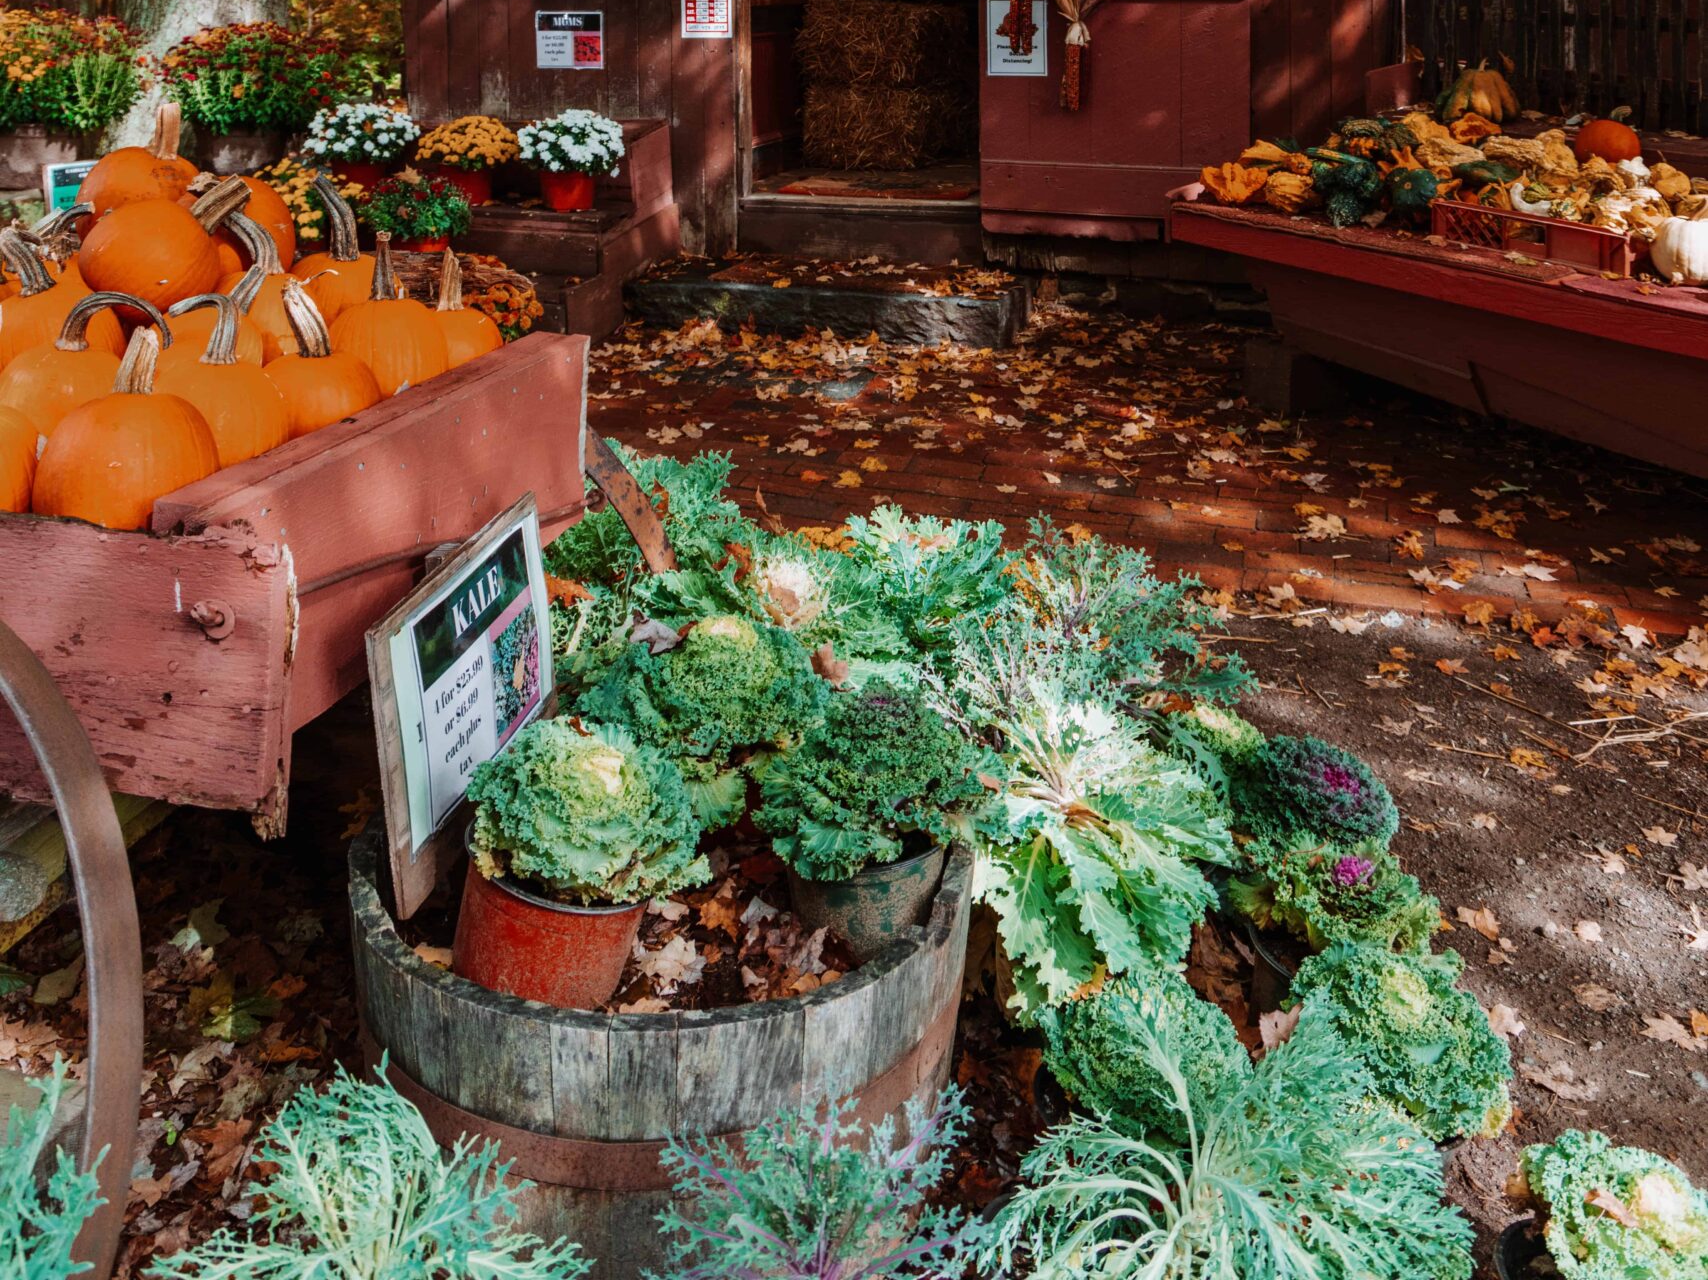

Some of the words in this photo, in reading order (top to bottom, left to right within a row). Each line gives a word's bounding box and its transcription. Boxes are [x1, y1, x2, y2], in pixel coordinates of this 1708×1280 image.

[451, 566, 501, 639] KALE
[441, 688, 455, 709] for
[444, 717, 455, 735] or
[455, 687, 479, 723] $6.99
[445, 732, 465, 763] each
[466, 714, 482, 745] plus
[459, 755, 473, 775] tax
